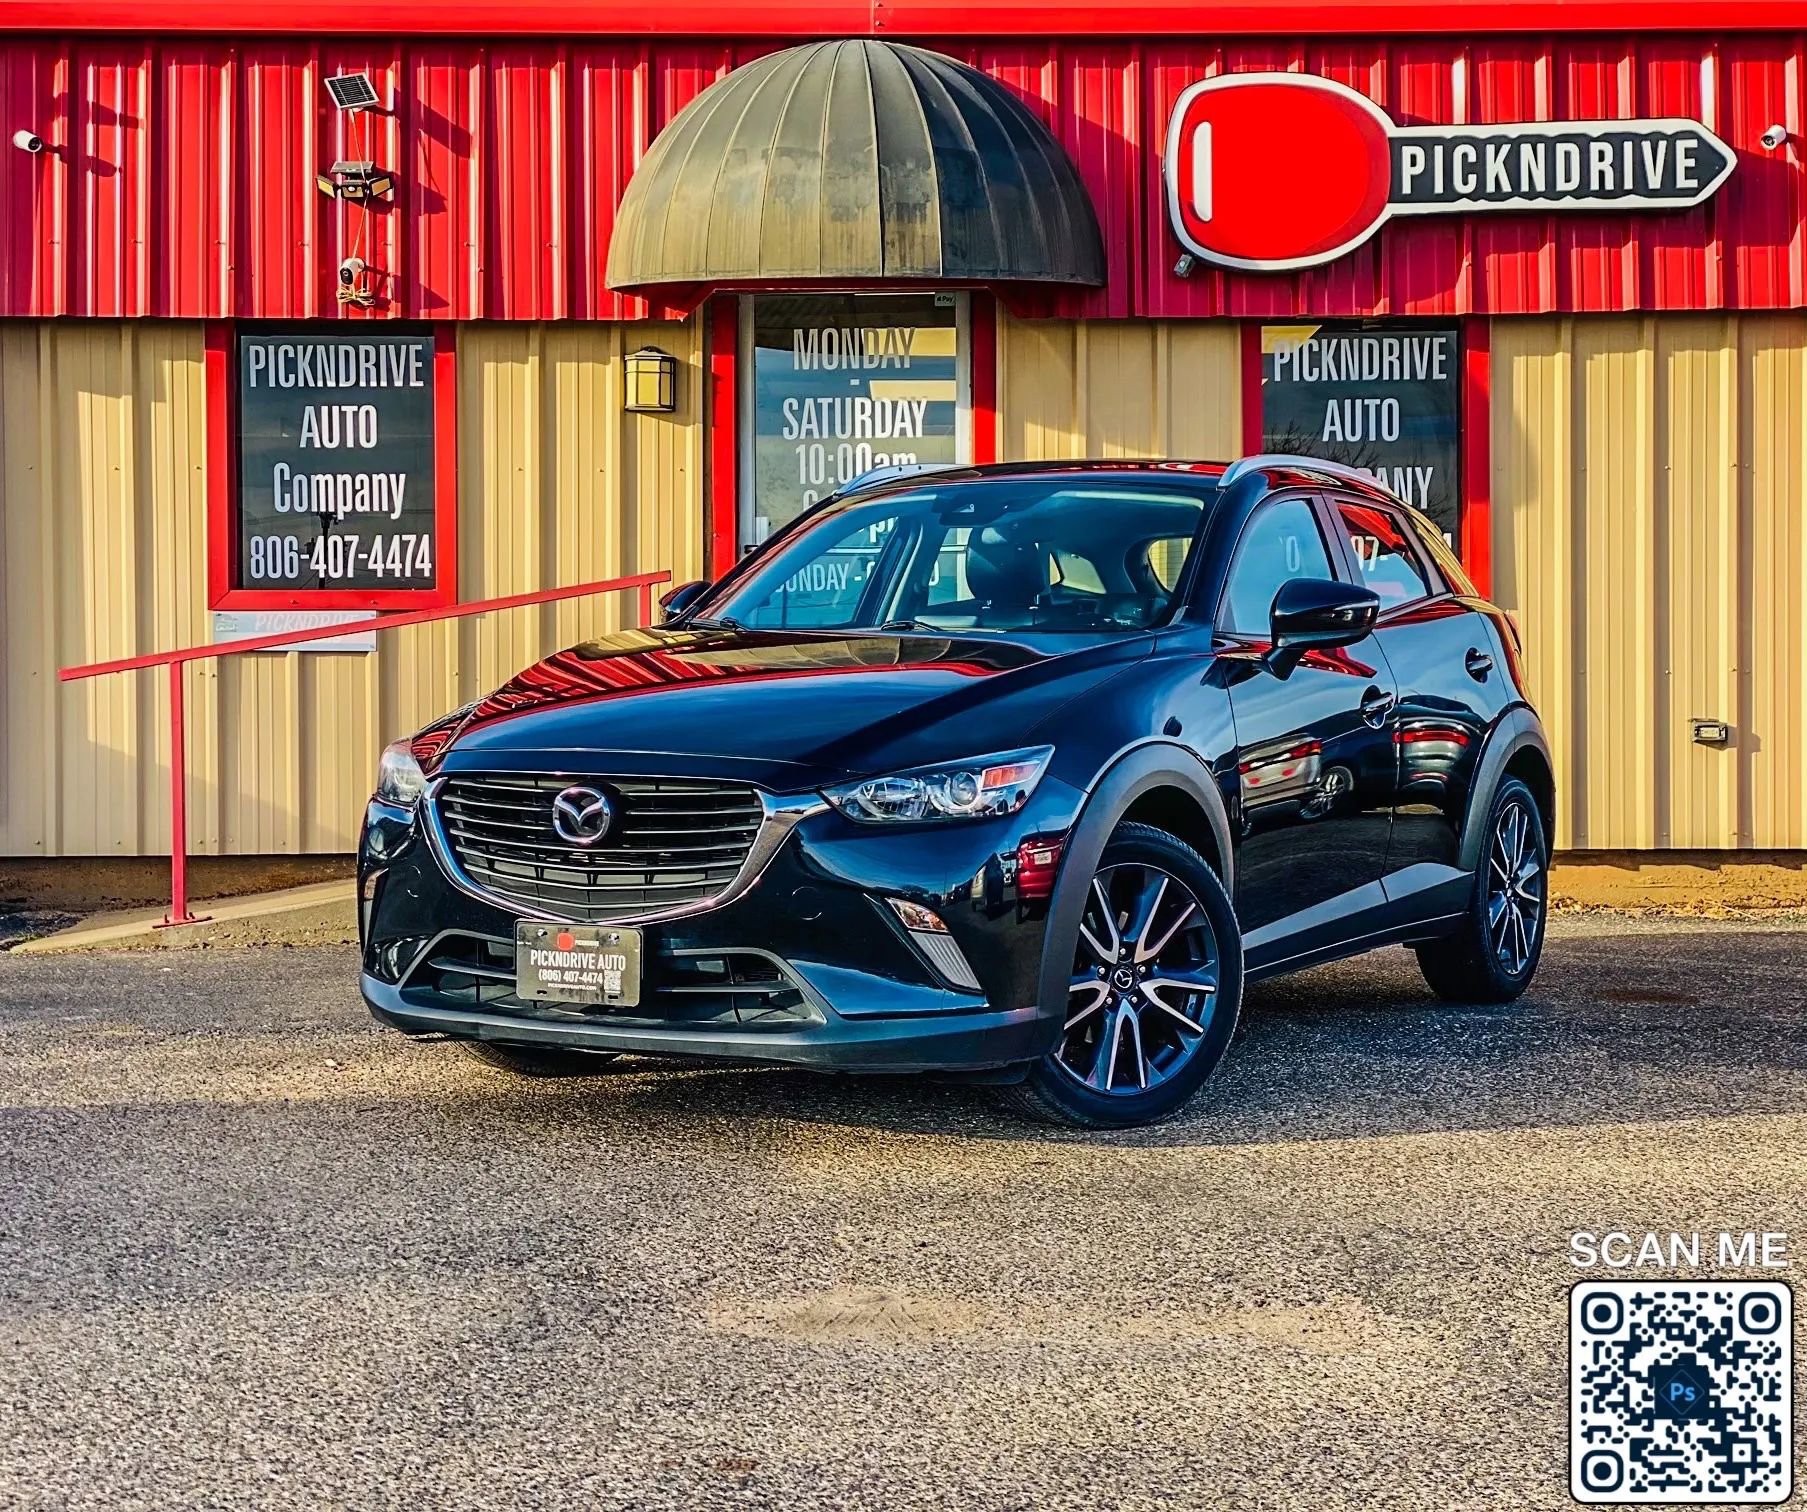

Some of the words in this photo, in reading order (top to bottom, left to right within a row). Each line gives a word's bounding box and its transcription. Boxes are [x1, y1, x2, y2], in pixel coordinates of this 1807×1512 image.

[1401, 138, 1699, 195] PICKNDRIVE
[249, 344, 425, 388] PICKNDRIVE
[793, 327, 916, 371] MONDAY
[1272, 336, 1449, 382] PICKNDRIVE
[299, 404, 379, 450] AUTO
[782, 397, 928, 441] SATURDAY
[1322, 397, 1400, 443] AUTO
[273, 462, 406, 521] Company
[249, 534, 432, 579] 806-407-4474
[775, 562, 850, 593] UNDAY
[255, 613, 360, 632] PICKNDR
[530, 949, 596, 970] PICKNDRIVE
[597, 954, 626, 972] AUTO
[538, 968, 562, 983] (806)
[563, 969, 604, 986] 407-4474
